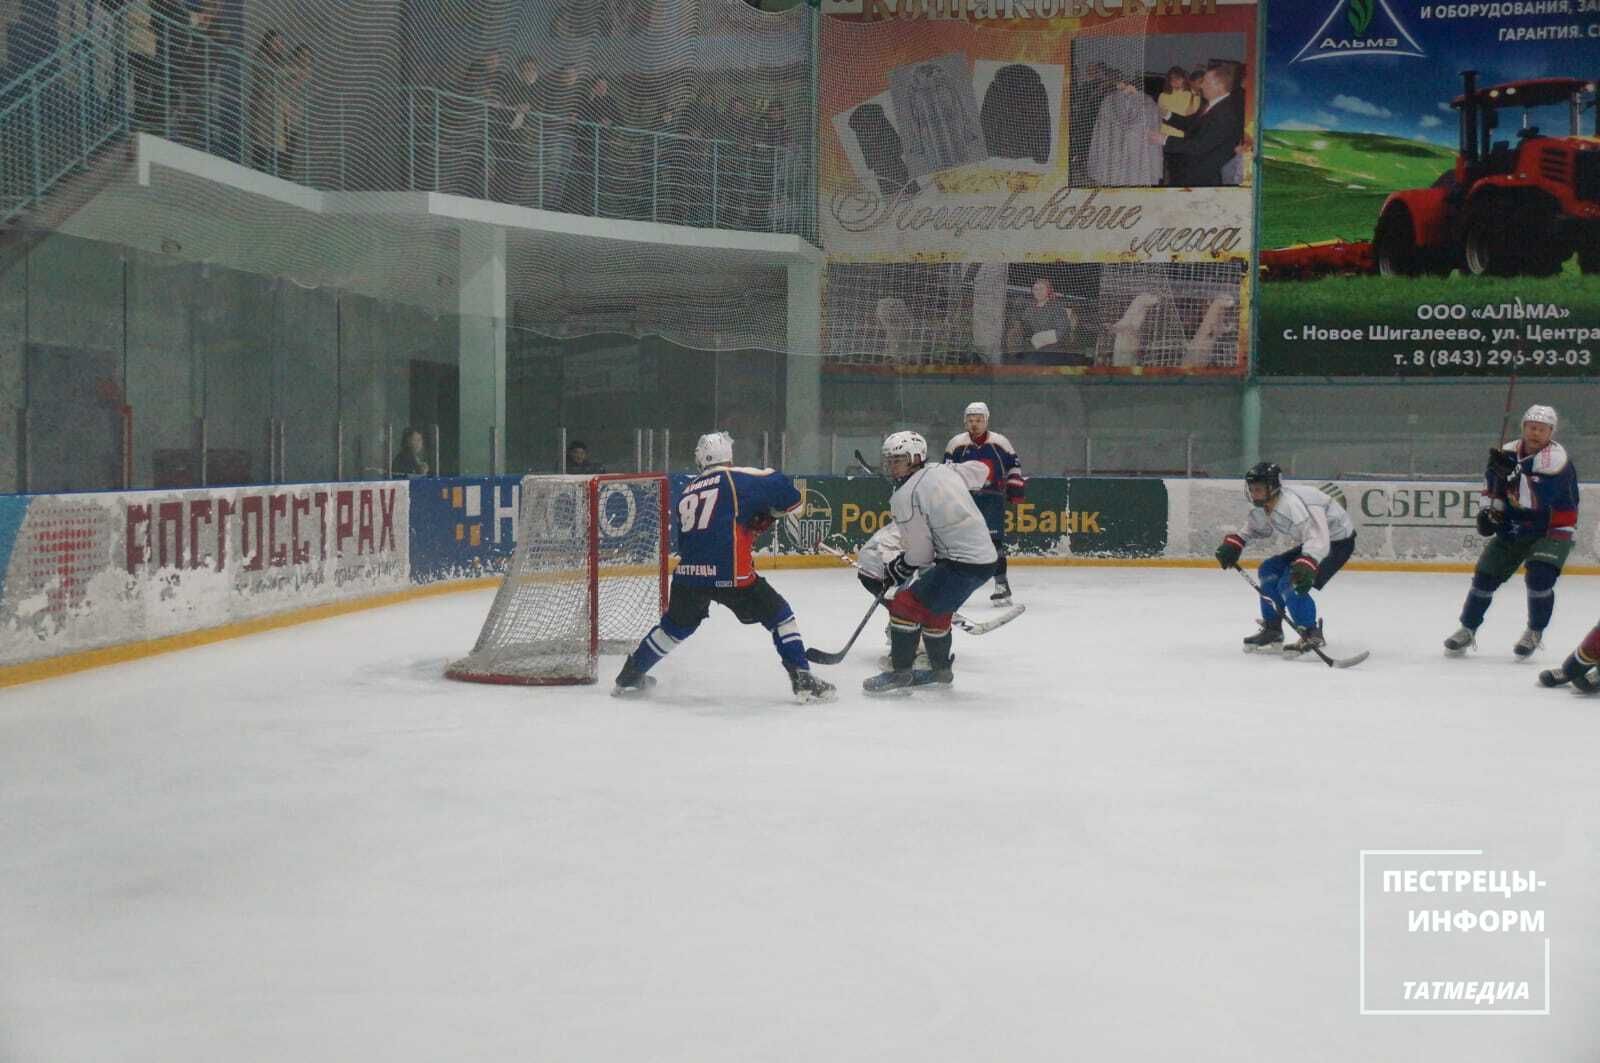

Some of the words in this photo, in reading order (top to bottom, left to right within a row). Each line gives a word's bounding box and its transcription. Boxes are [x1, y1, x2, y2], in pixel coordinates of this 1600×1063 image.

[1420, 6, 1431, 19] И
[1435, 0, 1573, 19] ОБОРУДОВАНИЯ,
[1498, 25, 1584, 41] ГАРАНТИЯ.
[1588, 24, 1600, 38] С
[1320, 38, 1398, 49] Альма
[1417, 304, 1466, 320] ООО
[1471, 303, 1571, 320] «АЛЬМА»
[1282, 328, 1298, 340] с.
[1302, 325, 1364, 341] Новое
[1368, 325, 1487, 342] Шигалеево,
[1491, 328, 1520, 344] ул.
[1393, 353, 1408, 366] т.
[1412, 350, 1425, 365] 8
[1429, 349, 1483, 368] (843)
[1361, 488, 1484, 520] СБЕРБ
